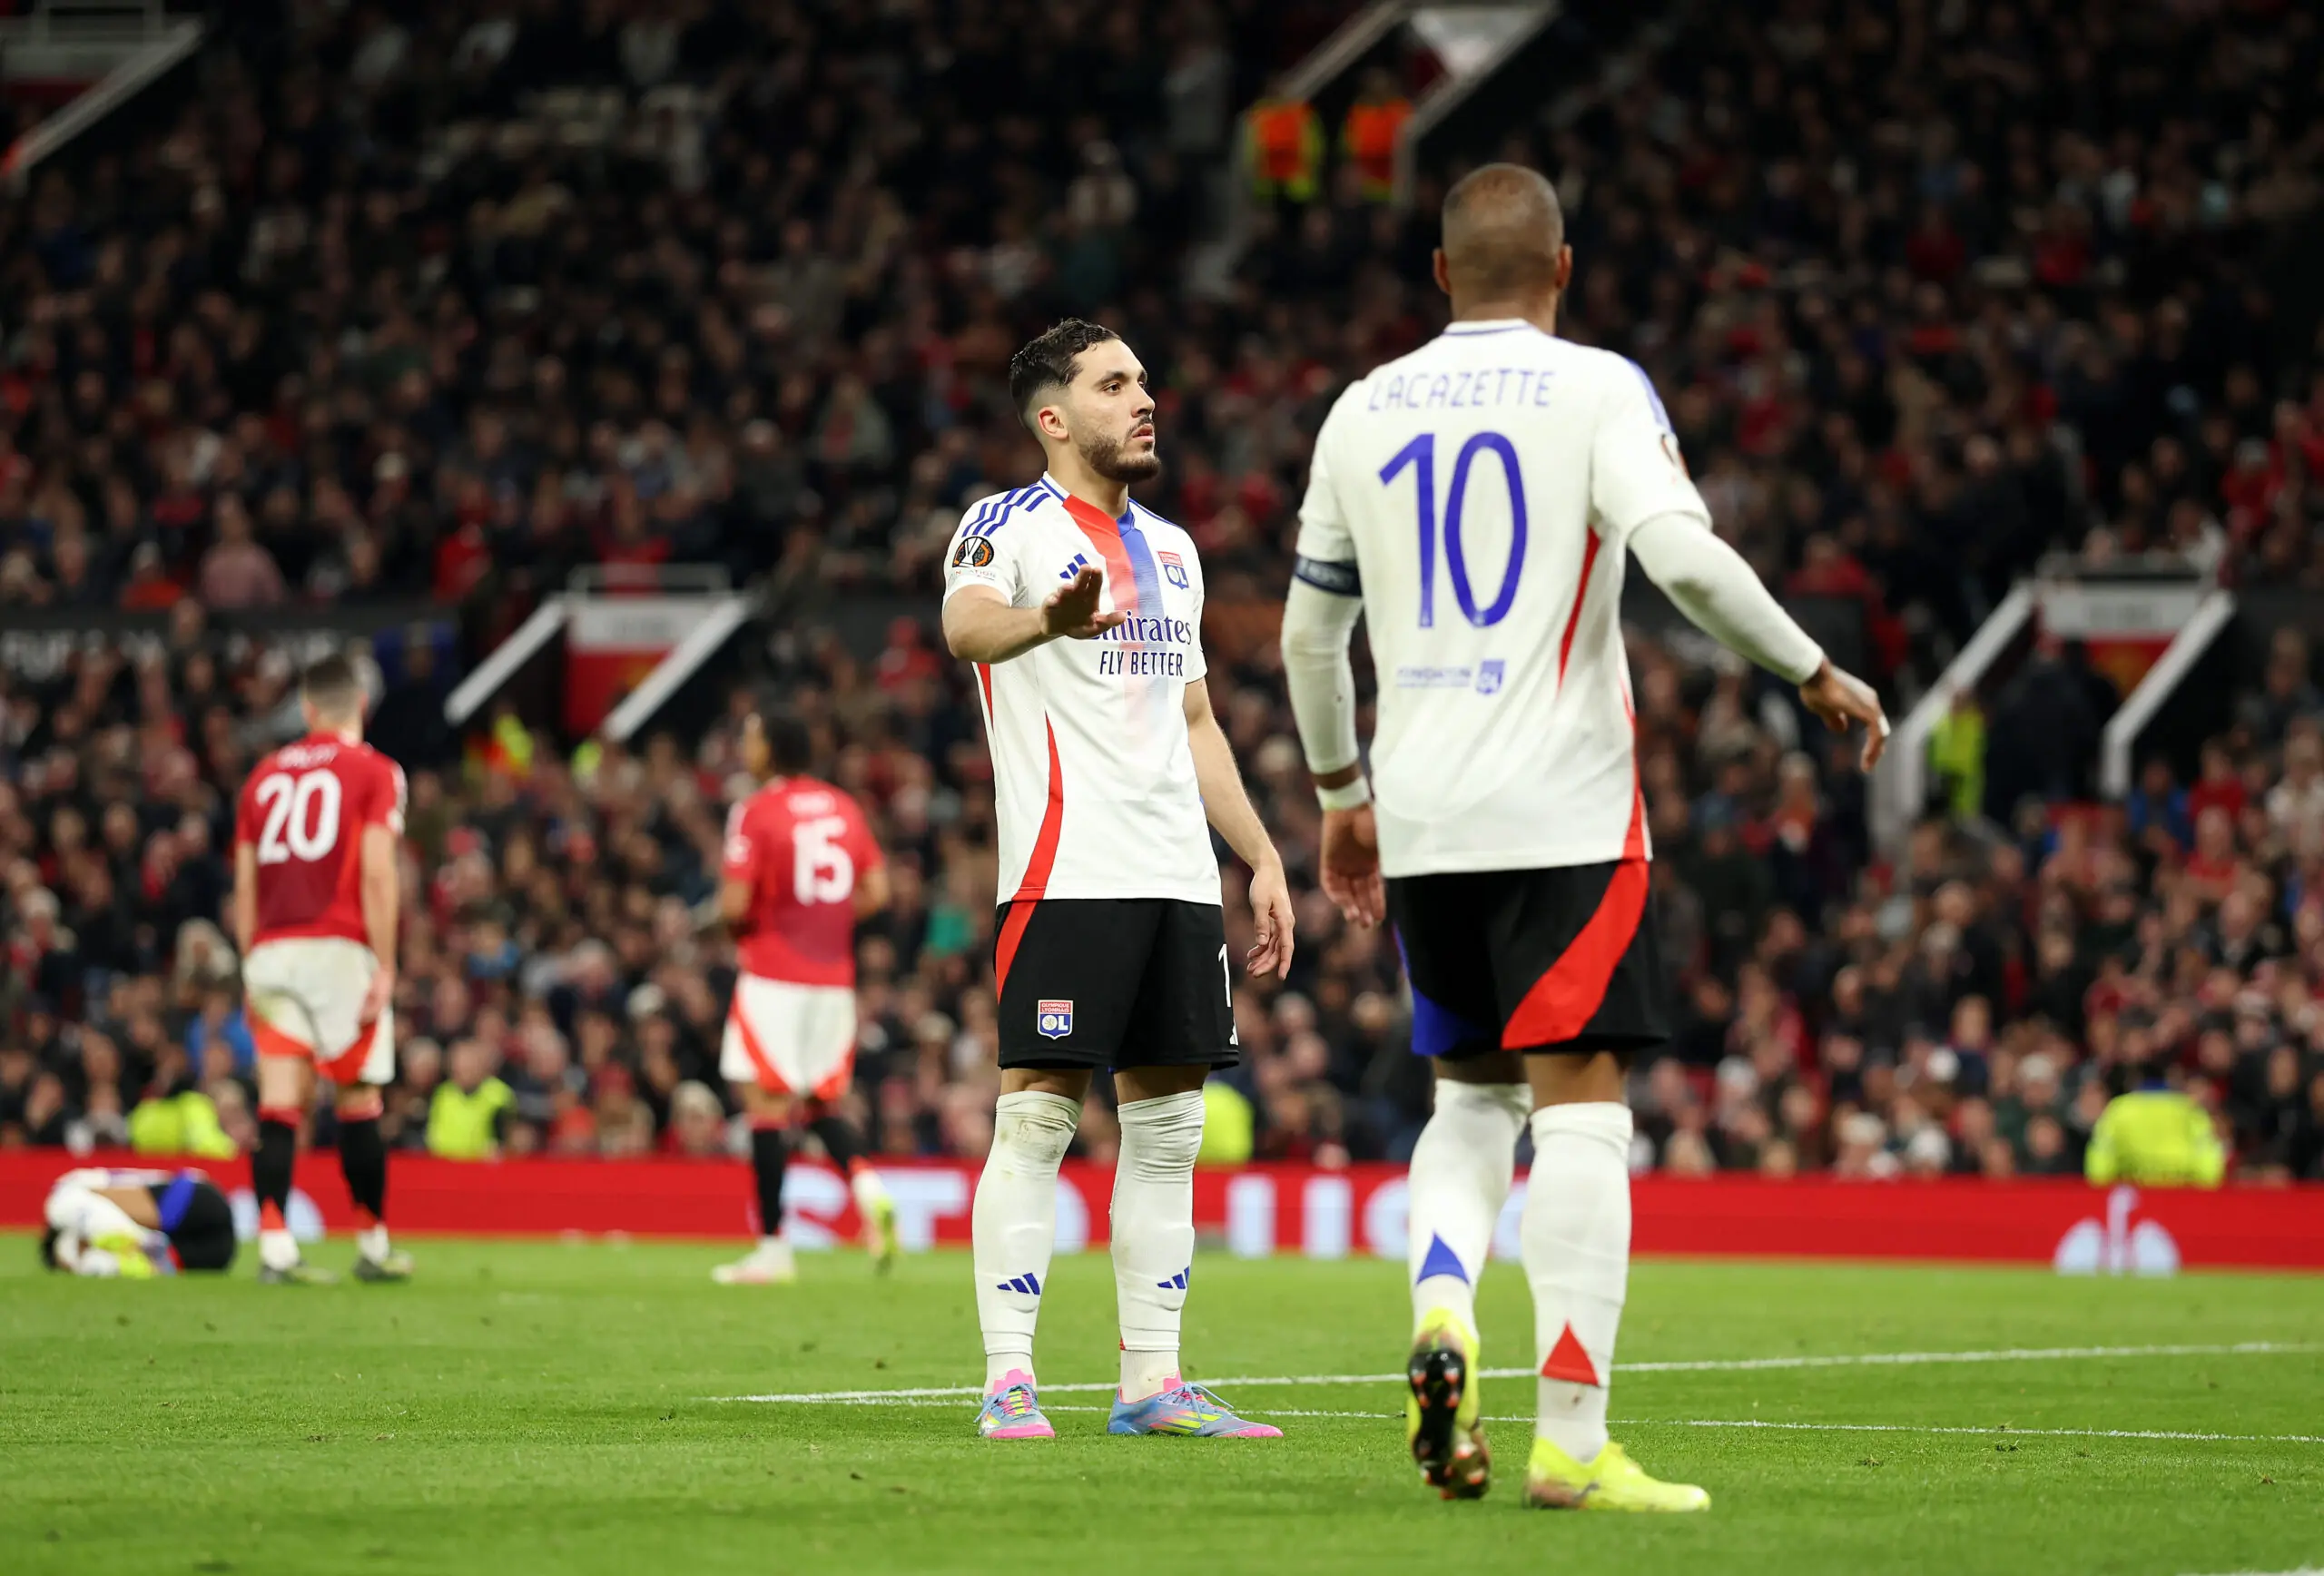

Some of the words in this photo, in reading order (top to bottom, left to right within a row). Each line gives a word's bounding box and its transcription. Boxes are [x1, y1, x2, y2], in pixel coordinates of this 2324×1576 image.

[1368, 369, 1556, 410] LACAZETTE
[1378, 431, 1529, 629] 10
[1099, 651, 1125, 675] FLY
[1130, 652, 1184, 676] BETTER
[255, 768, 341, 864] 20
[793, 816, 855, 905] 15
[1041, 1014, 1068, 1031] OL
